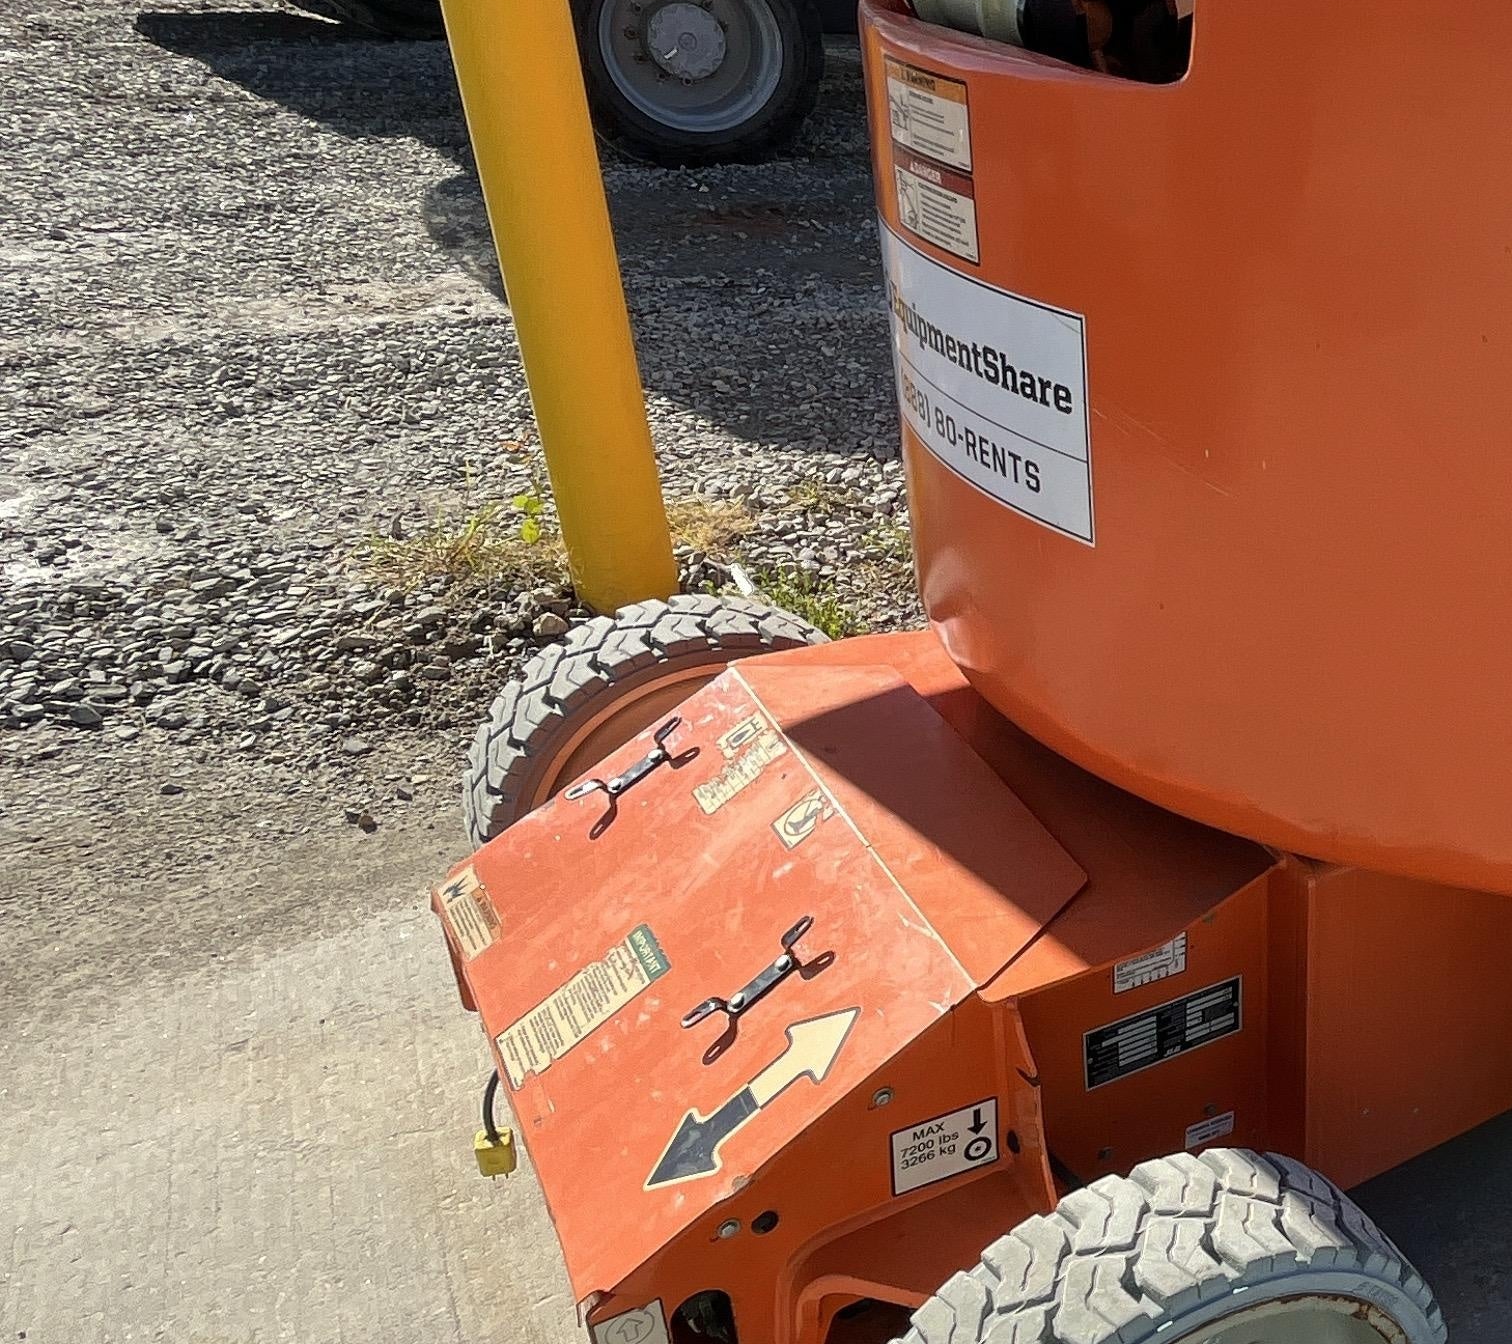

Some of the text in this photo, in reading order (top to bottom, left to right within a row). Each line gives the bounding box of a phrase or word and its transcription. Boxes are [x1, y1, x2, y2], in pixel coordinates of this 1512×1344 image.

[935, 409, 1041, 495] 80-RENTS
[900, 1131, 960, 1159] 7200 lbs
[912, 1121, 945, 1142] MAX
[900, 1143, 957, 1170] 3266 kg
